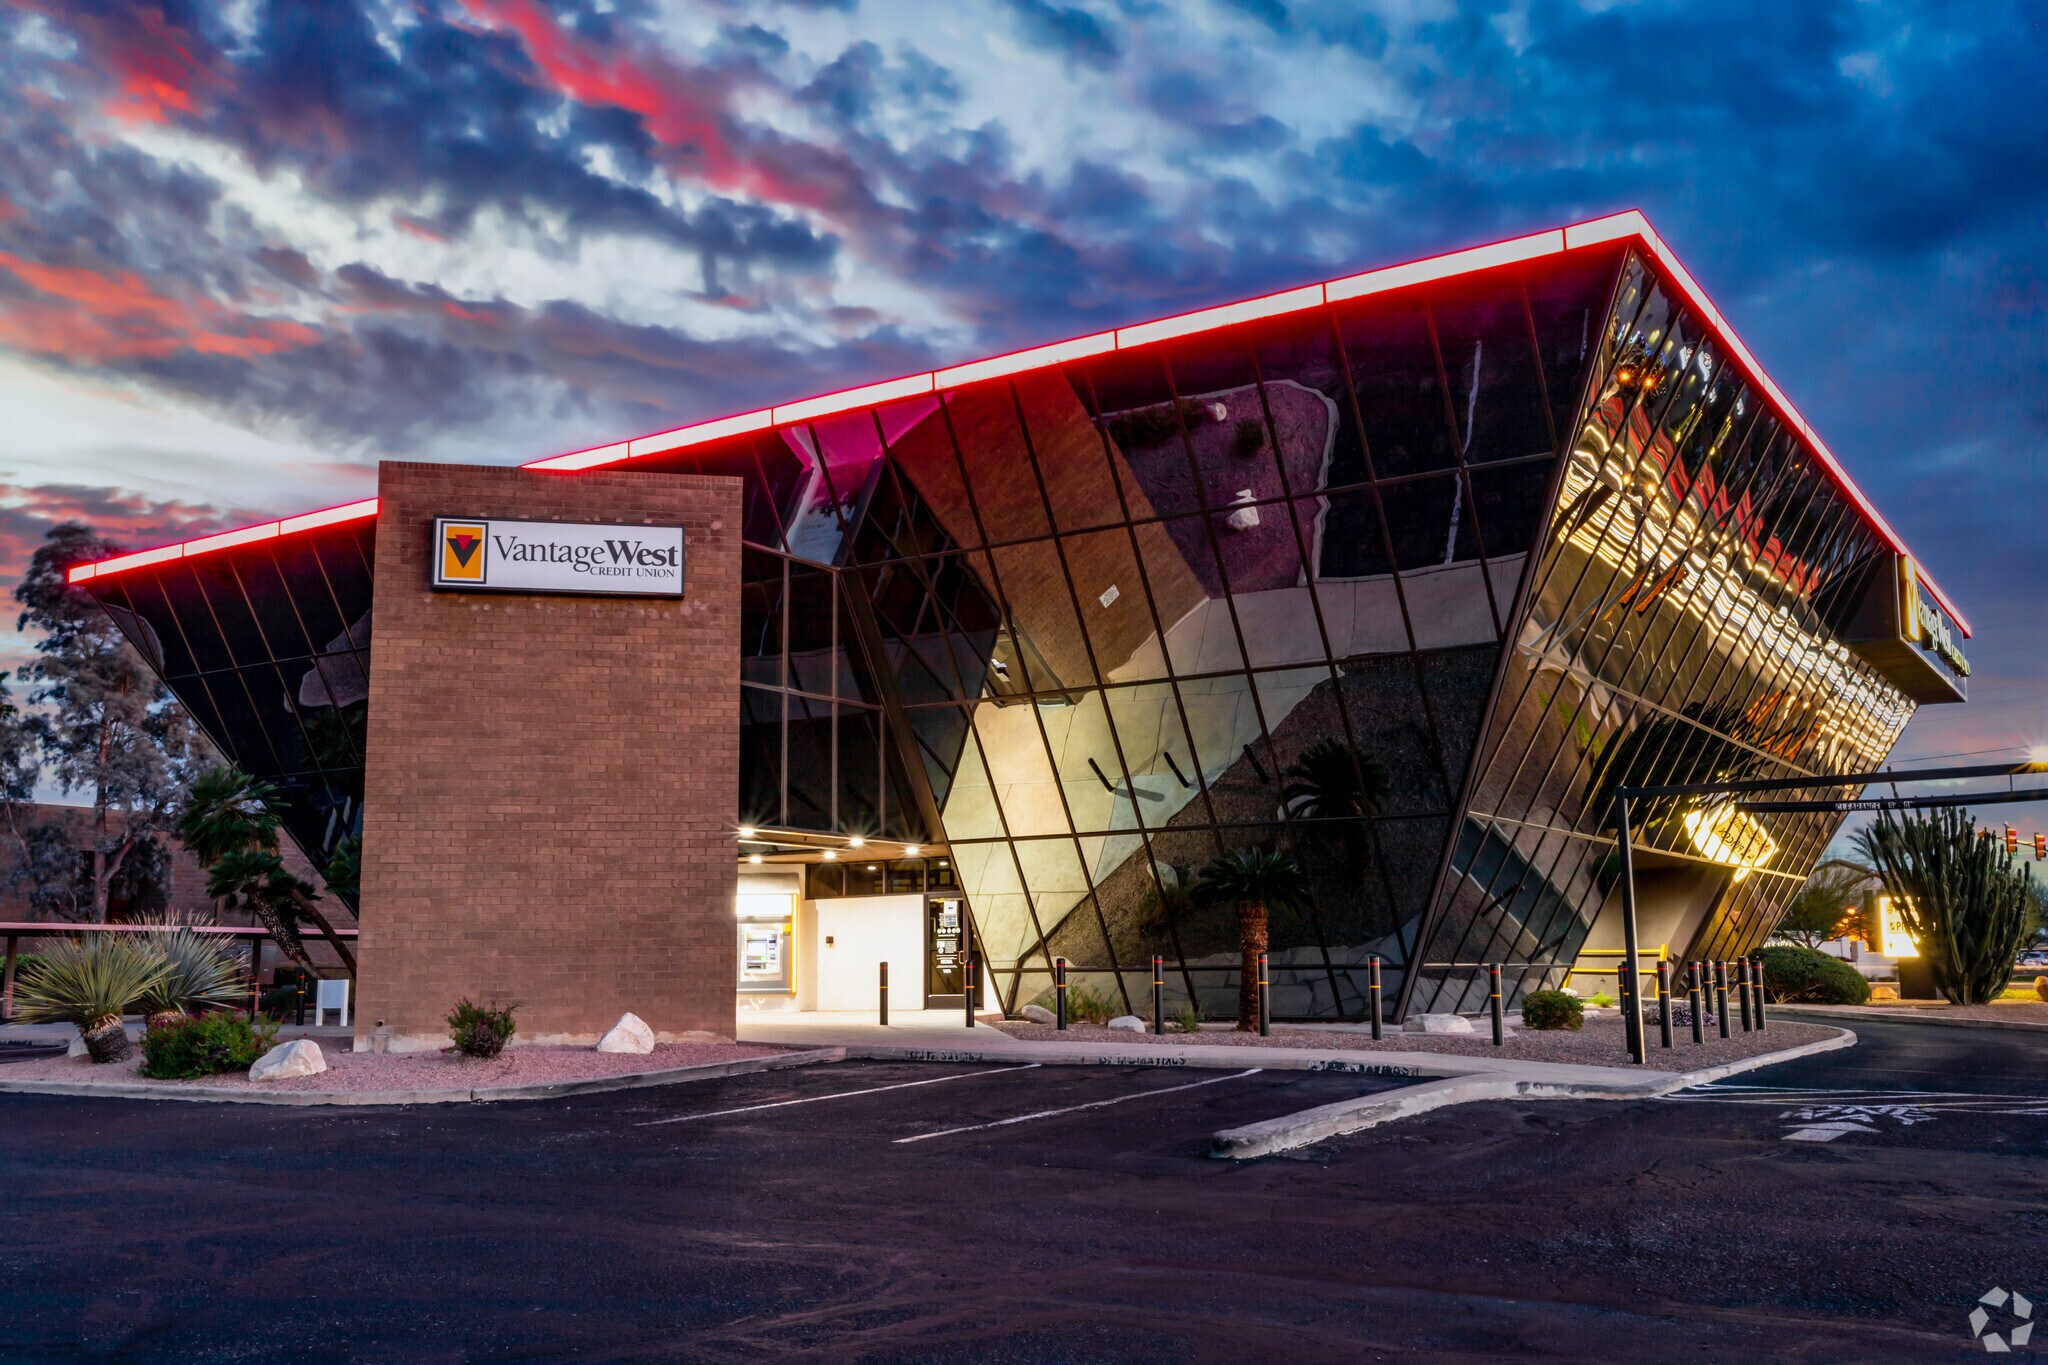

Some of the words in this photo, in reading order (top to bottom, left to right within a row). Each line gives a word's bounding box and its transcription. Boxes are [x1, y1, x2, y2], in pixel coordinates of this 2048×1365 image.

[493, 535, 679, 573] VantageWest
[590, 566, 633, 577] CREDIT
[636, 568, 675, 578] UNION
[1835, 802, 1881, 811] CLEARANCE
